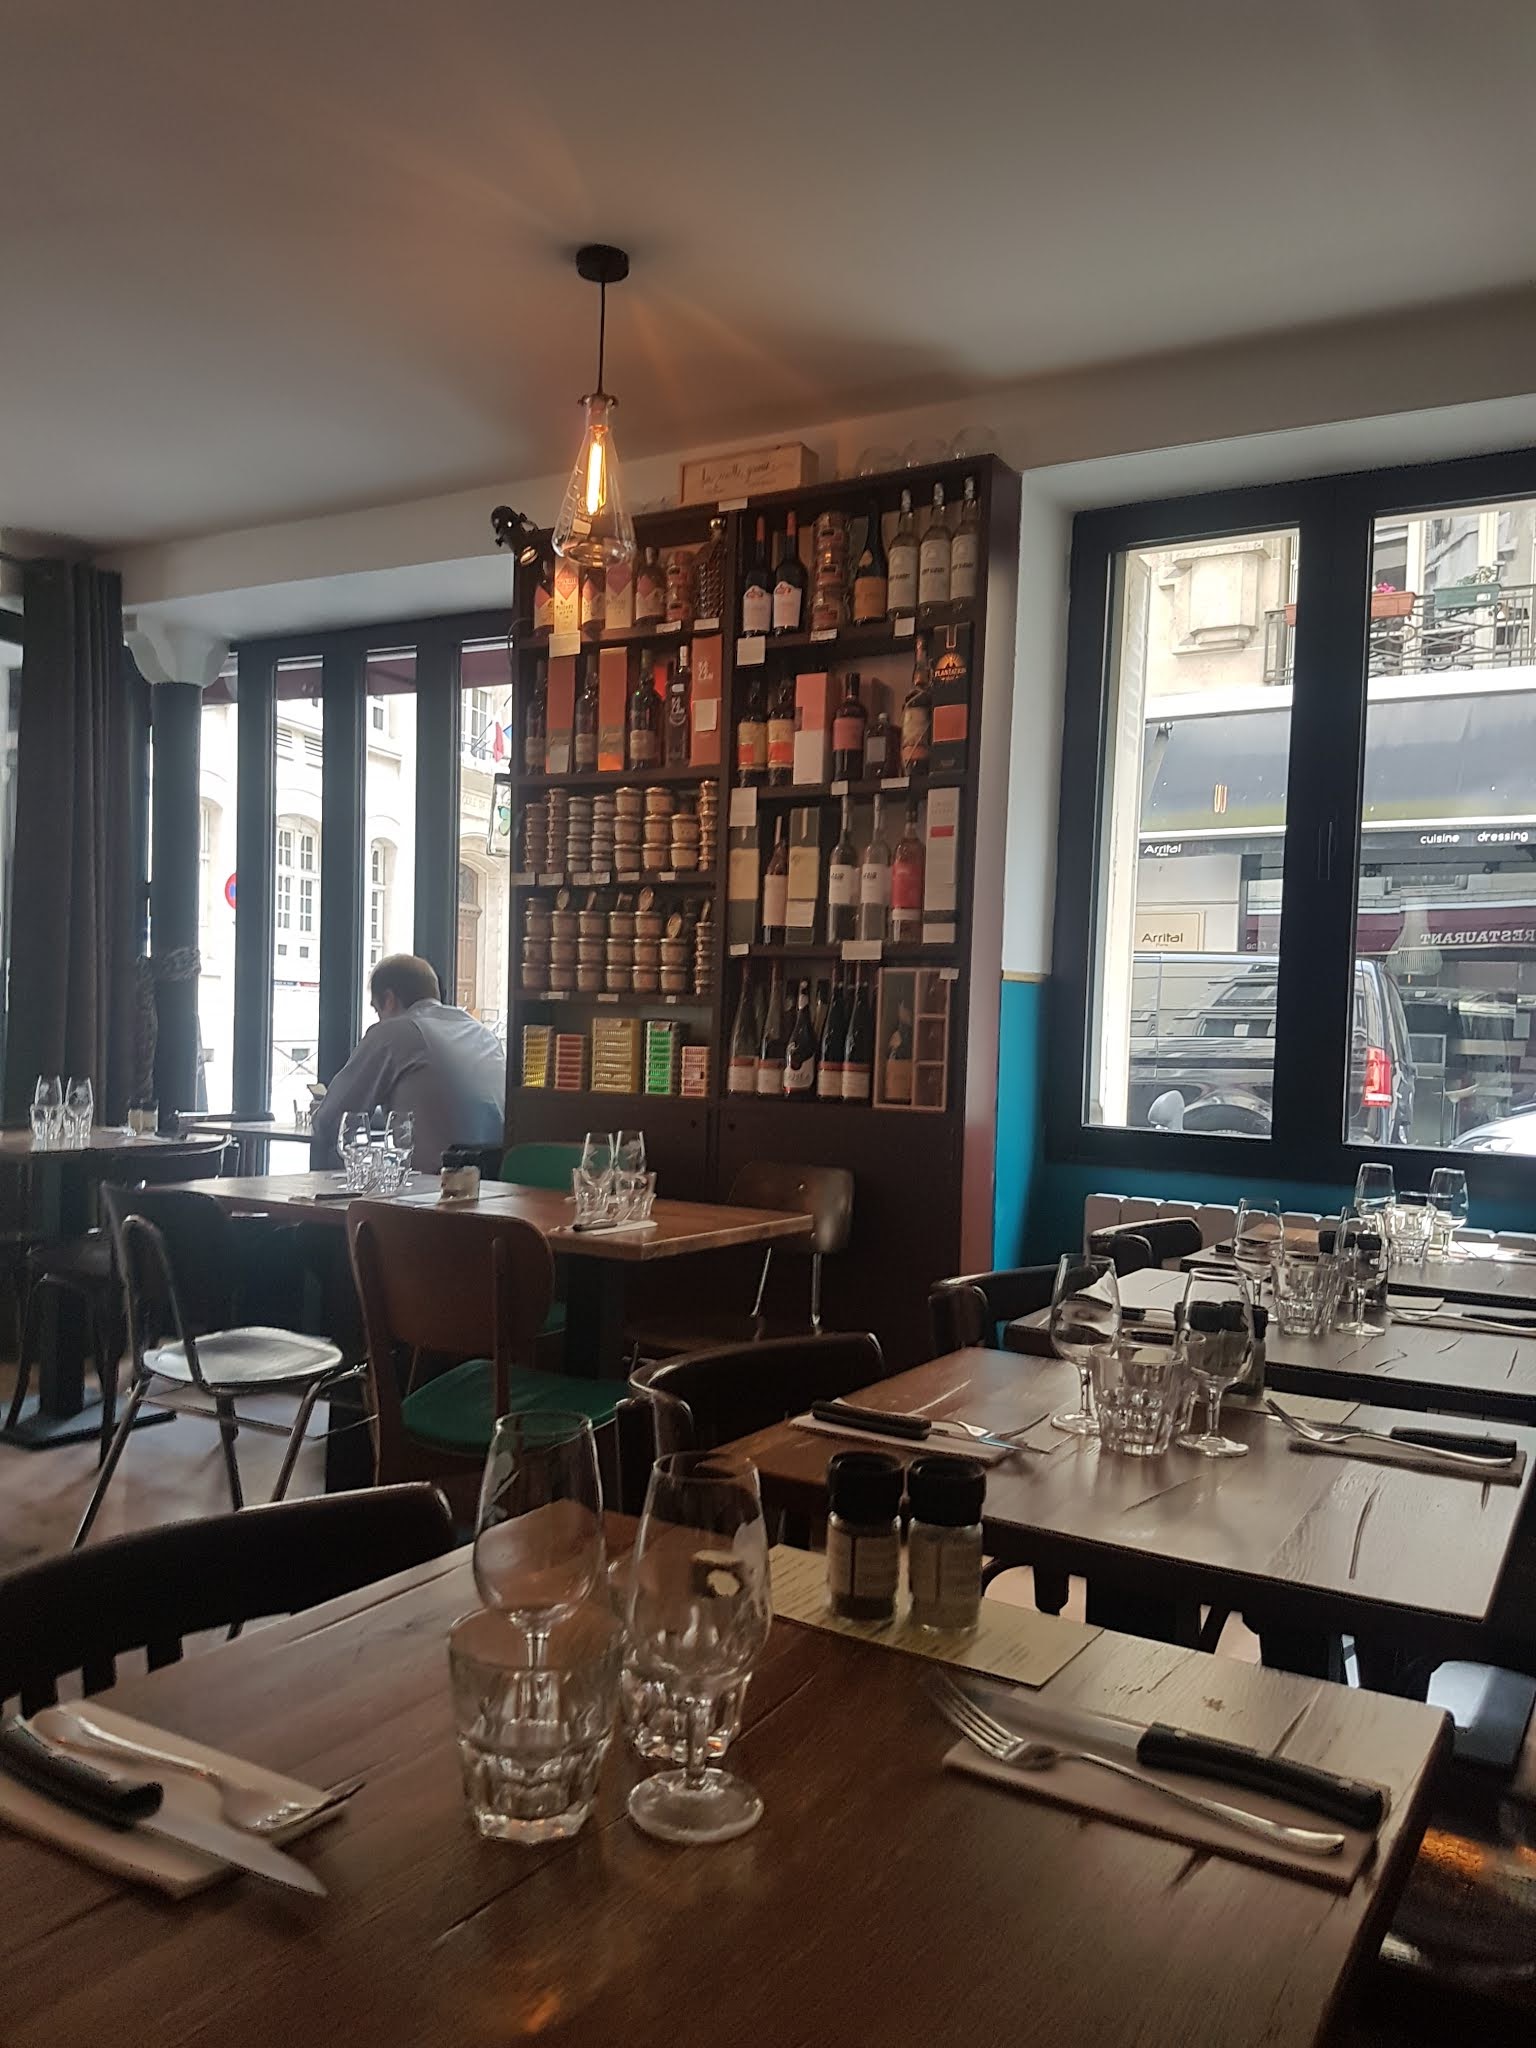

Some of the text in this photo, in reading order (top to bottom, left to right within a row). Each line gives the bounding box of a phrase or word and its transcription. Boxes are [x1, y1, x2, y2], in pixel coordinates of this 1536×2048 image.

[1420, 831, 1529, 844] cuisine dressing
[1144, 844, 1182, 854] Arrital
[1141, 932, 1184, 943] Arrital
